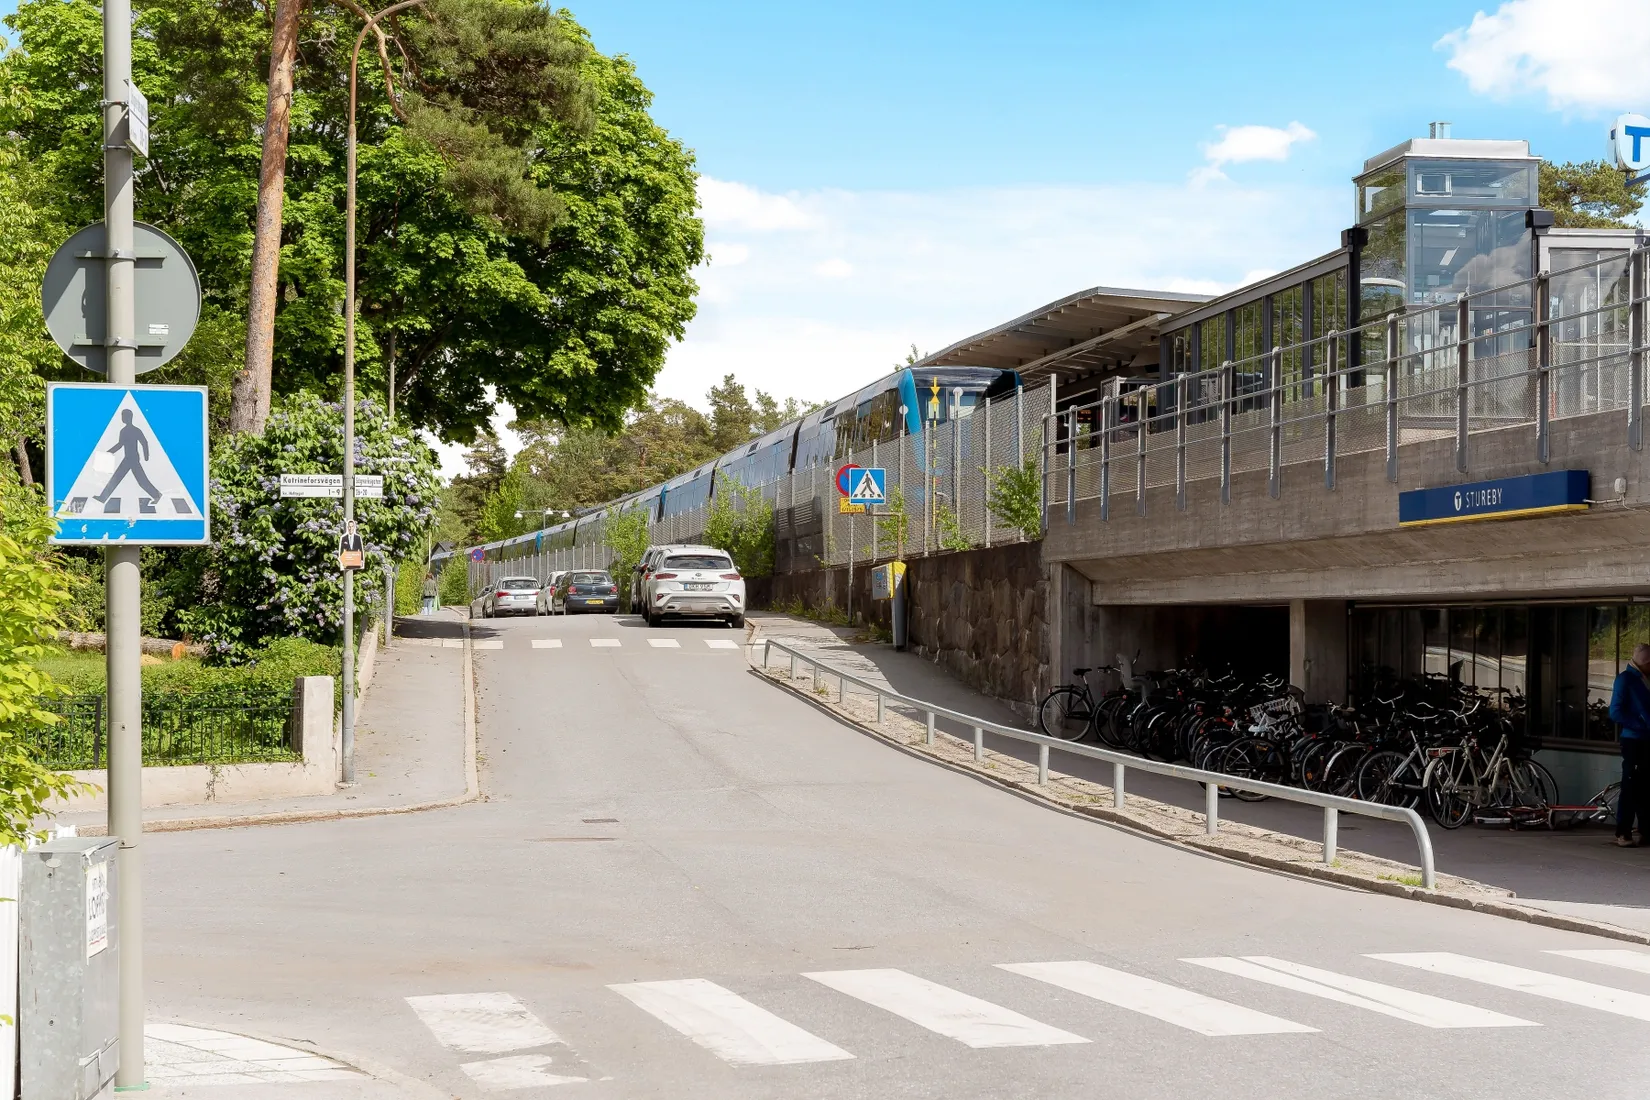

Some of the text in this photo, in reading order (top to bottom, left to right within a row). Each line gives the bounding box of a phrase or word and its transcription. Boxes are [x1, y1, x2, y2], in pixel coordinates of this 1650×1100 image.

[1625, 125, 1650, 162] T
[282, 476, 341, 485] Katrineforsvägen
[1466, 488, 1502, 508] STUREBY
